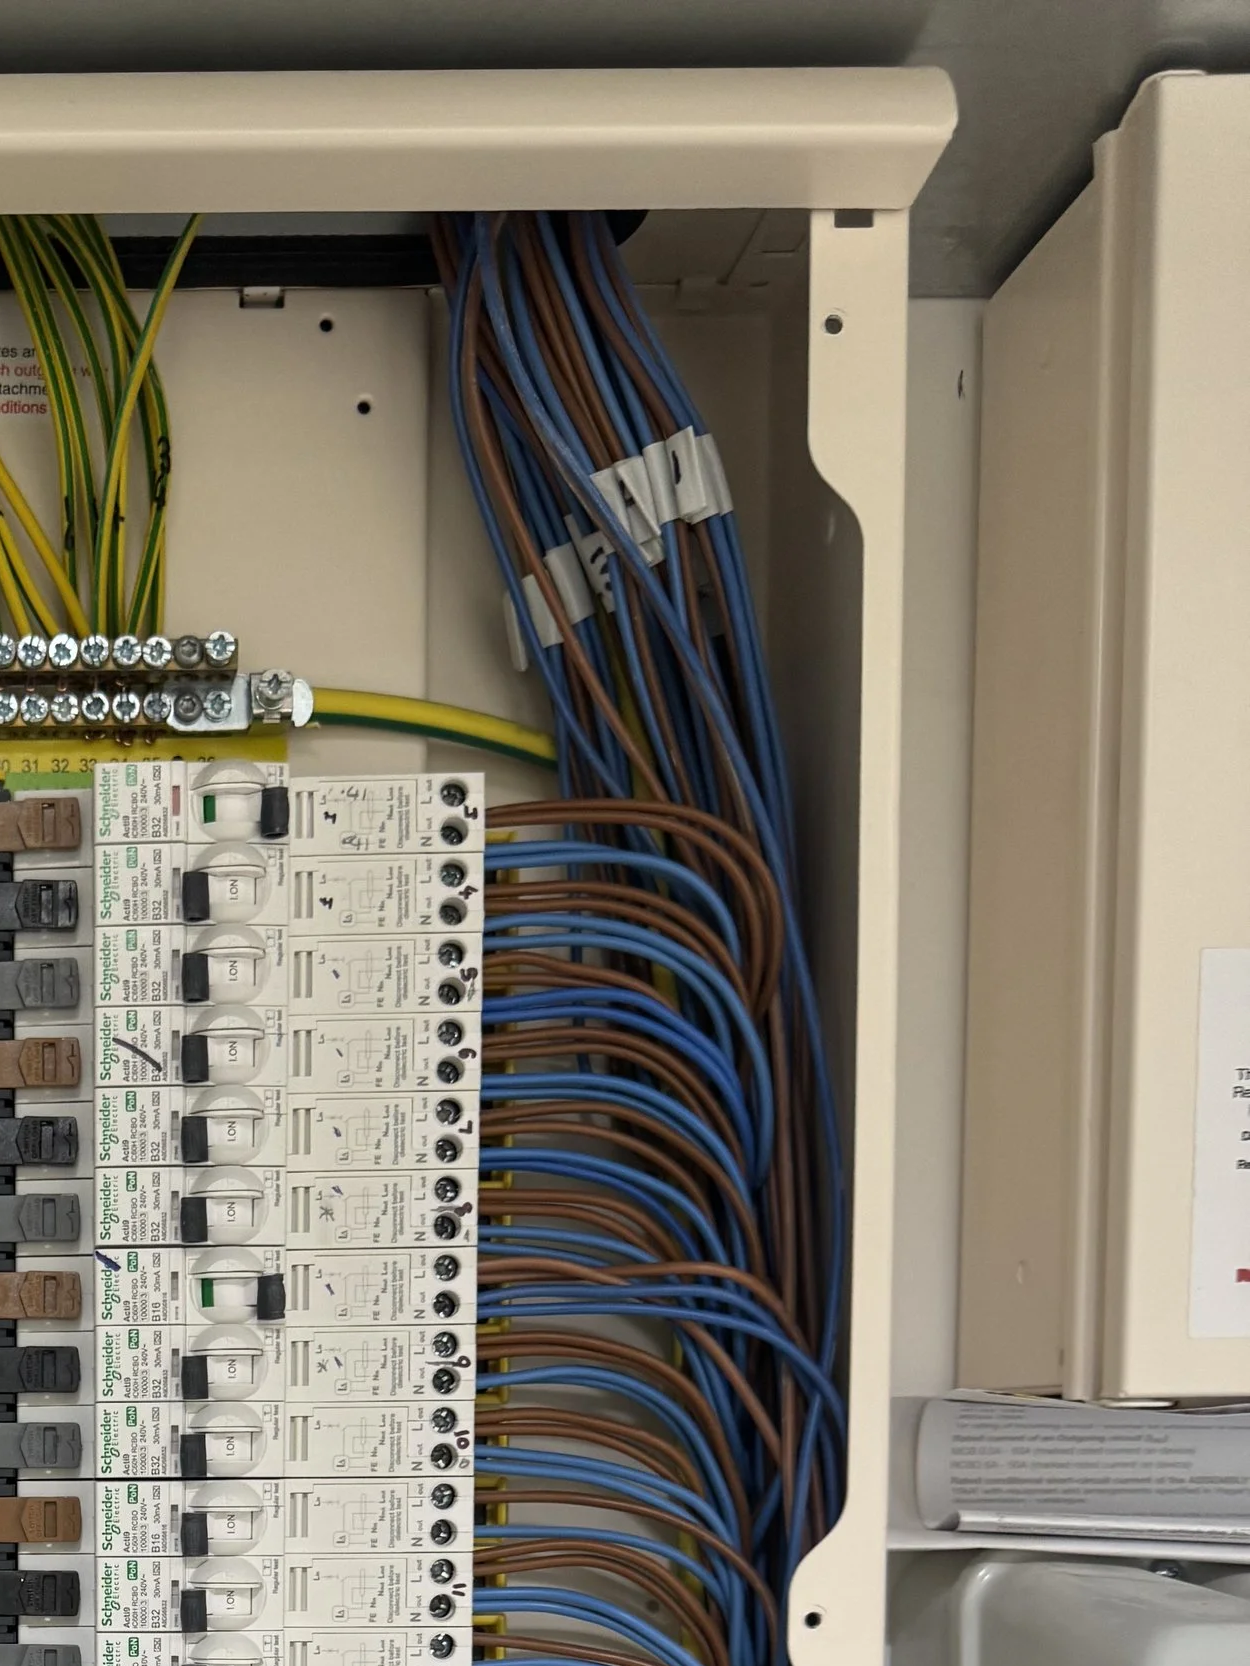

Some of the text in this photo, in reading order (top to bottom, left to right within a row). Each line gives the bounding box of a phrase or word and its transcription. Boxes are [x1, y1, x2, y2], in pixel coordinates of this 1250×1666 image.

[22, 759, 39, 773] 31
[52, 759, 69, 773] 32
[100, 768, 111, 837] Schneider
[152, 816, 161, 838] B32
[101, 851, 112, 920] Schneider
[229, 879, 239, 900] I.ON
[152, 899, 162, 920] B32
[100, 933, 112, 1001] Schneider
[229, 960, 238, 981] I.ON
[152, 979, 162, 1002] B32
[127, 1012, 136, 1030] PoN
[100, 1012, 112, 1081] Schneider
[229, 1041, 238, 1061] I.ON
[127, 1092, 135, 1111] PoN
[99, 1093, 111, 1161] Schneider
[227, 1120, 237, 1141] I.ON
[151, 1140, 161, 1161] B32
[100, 1173, 112, 1240] Schneider
[227, 1201, 236, 1222] I.ON
[151, 1220, 160, 1241] B32
[128, 1253, 136, 1271] PoN
[152, 1301, 161, 1322] B16
[130, 1330, 138, 1348] PoN
[103, 1332, 114, 1397] Schneider
[227, 1359, 237, 1379] I.ON
[153, 1378, 162, 1398] B32
[102, 1409, 113, 1474] Schneider
[226, 1436, 236, 1456] I.ON
[151, 1455, 160, 1475] B32
[128, 1485, 136, 1503] PoN
[102, 1486, 113, 1551] Schneider
[226, 1514, 236, 1534] I.ON
[152, 1532, 160, 1553] B16
[102, 1562, 113, 1627] Schneider
[226, 1591, 236, 1610] I.ON
[152, 1608, 160, 1629] B32
[130, 1639, 138, 1656] PoN
